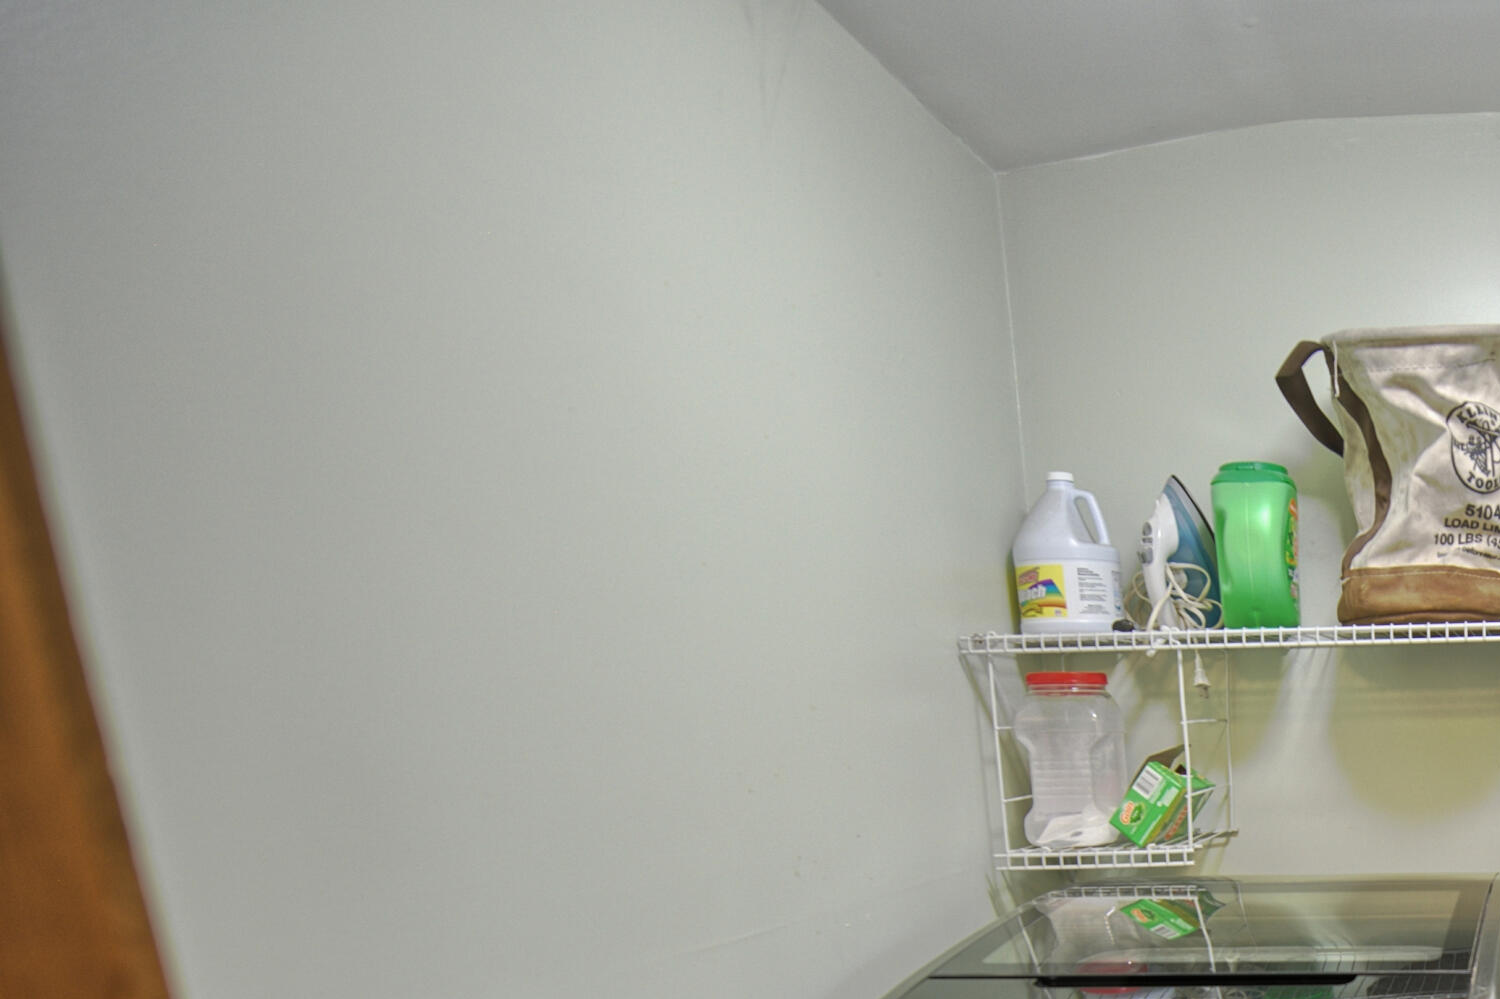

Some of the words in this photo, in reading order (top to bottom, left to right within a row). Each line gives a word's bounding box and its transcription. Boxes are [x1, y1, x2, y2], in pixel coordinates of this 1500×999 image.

[1444, 518, 1480, 530] LOAD
[1434, 533, 1455, 545] 100
[1458, 533, 1483, 545] LBS
